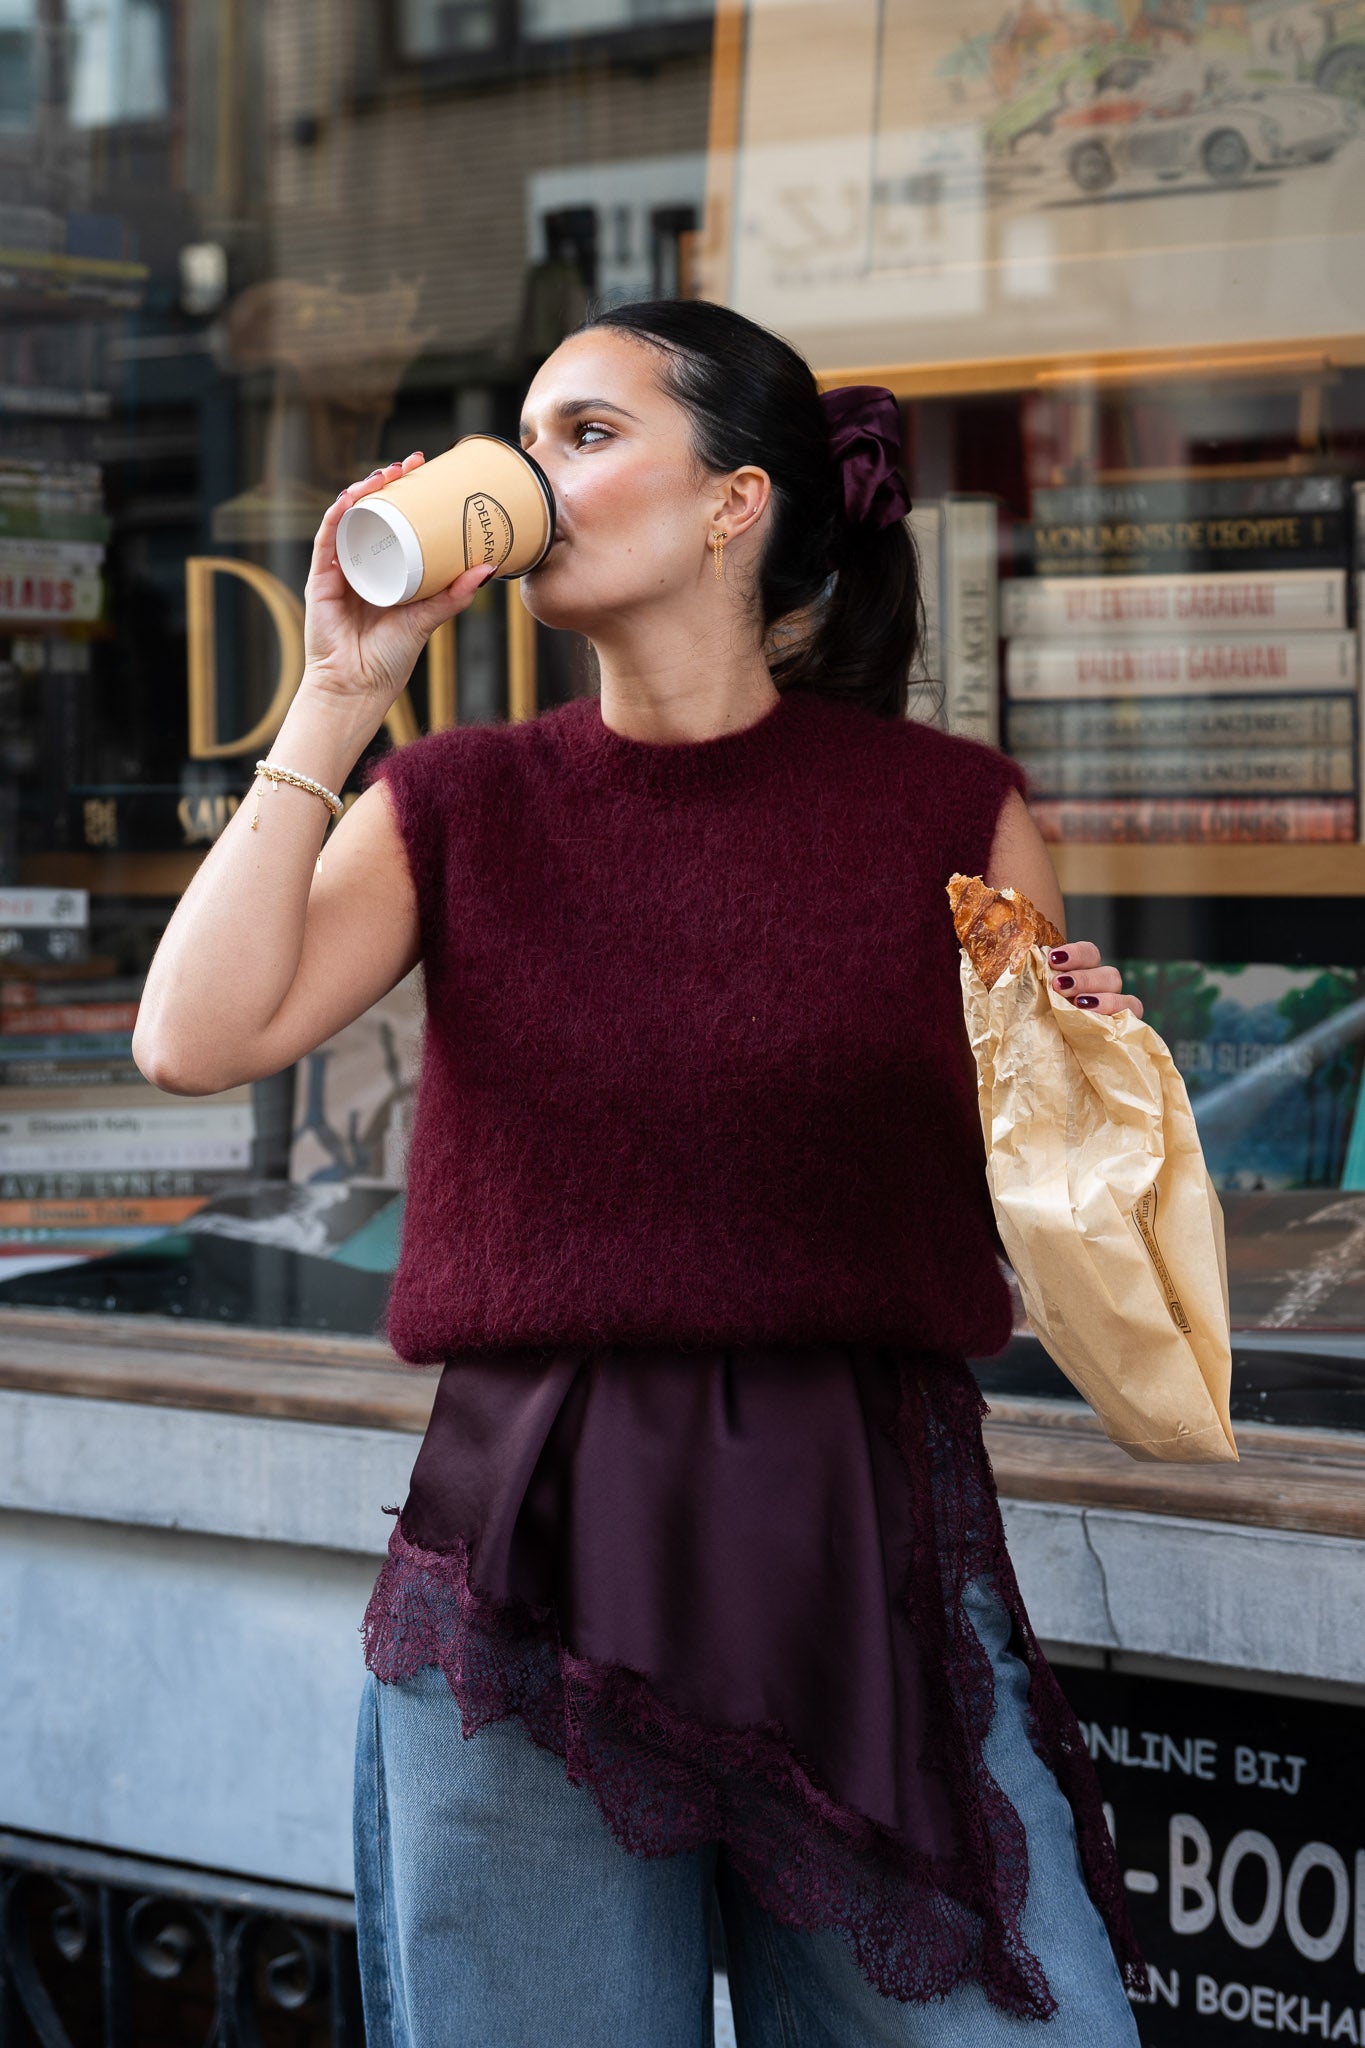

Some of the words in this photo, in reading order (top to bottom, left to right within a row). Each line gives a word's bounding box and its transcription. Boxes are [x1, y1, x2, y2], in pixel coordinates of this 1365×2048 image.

[1177, 520, 1204, 549] DE
[955, 580, 988, 719] PRAGUE
[93, 1168, 195, 1197] LYNCH
[1235, 1745, 1308, 1795] BIJ
